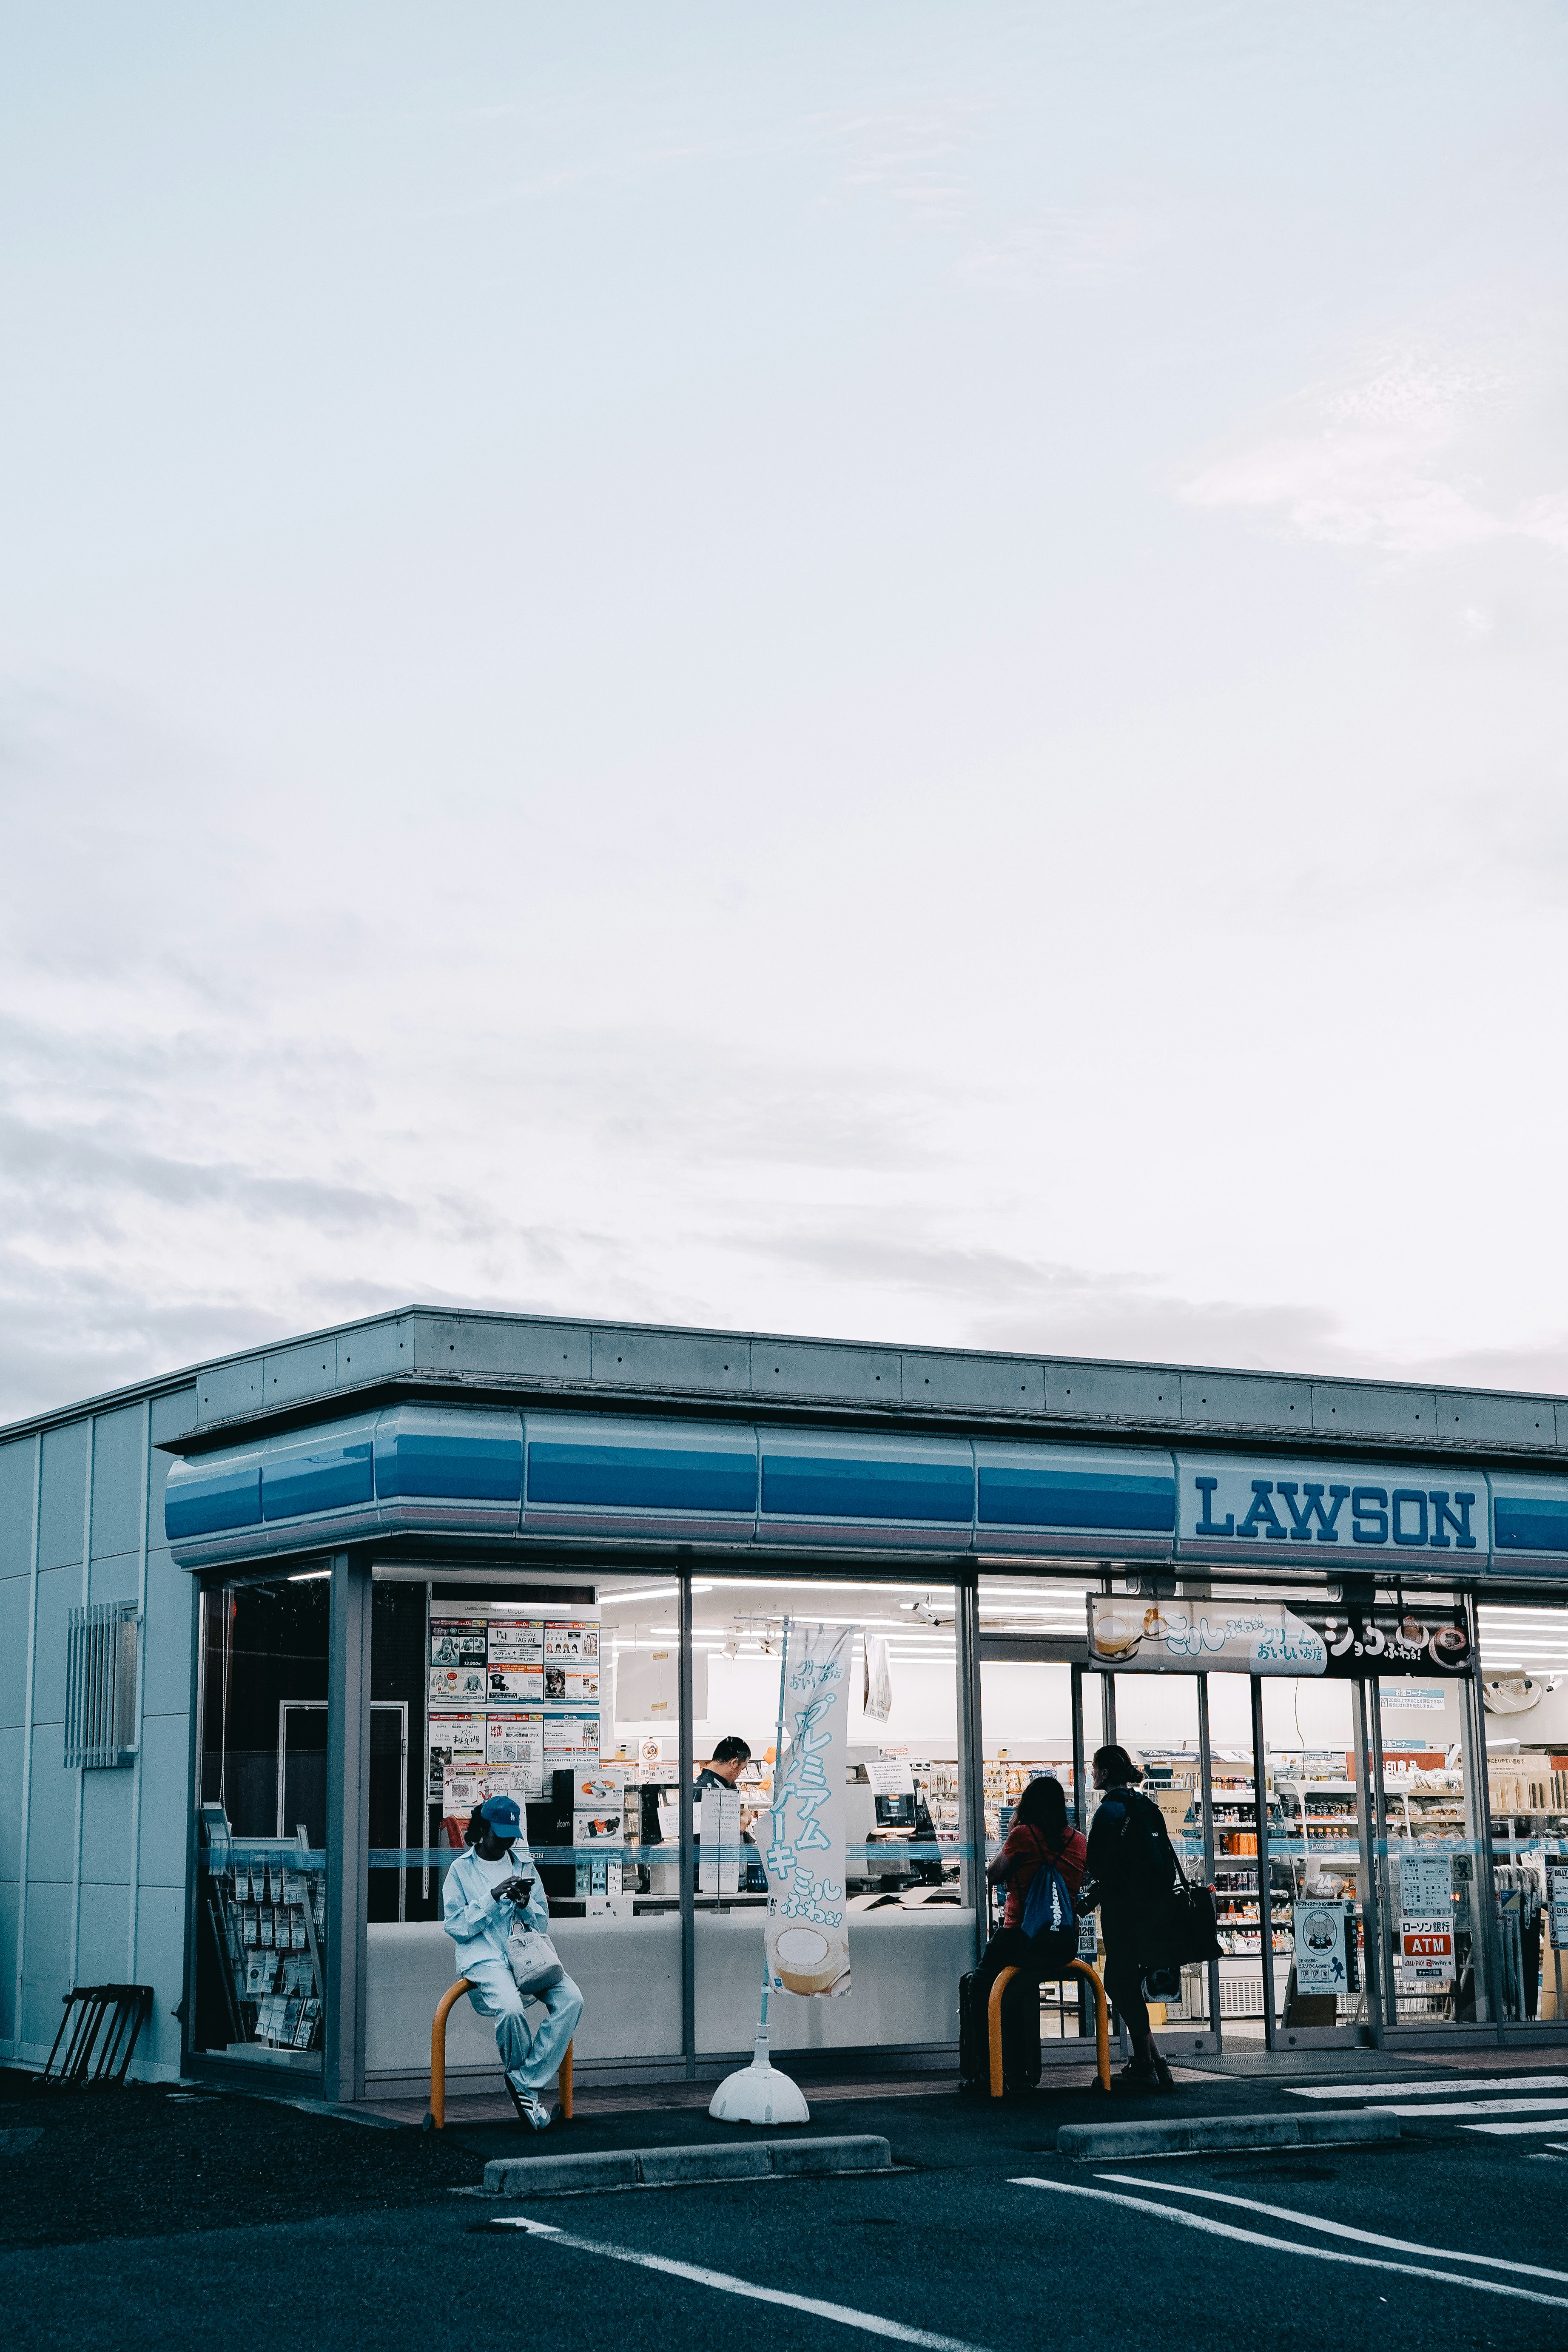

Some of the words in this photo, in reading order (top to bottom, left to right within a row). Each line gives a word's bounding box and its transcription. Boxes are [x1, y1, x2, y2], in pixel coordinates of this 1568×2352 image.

[1195, 1477, 1476, 1547] LAWSON
[1258, 1643, 1322, 1661] おいしいお店
[510, 1812, 515, 1821] LA
[556, 1819, 570, 1831] ploom
[1317, 1874, 1332, 1888] 24
[1403, 1921, 1450, 1933] ローソン銀行
[1412, 1938, 1444, 1953] ATM
